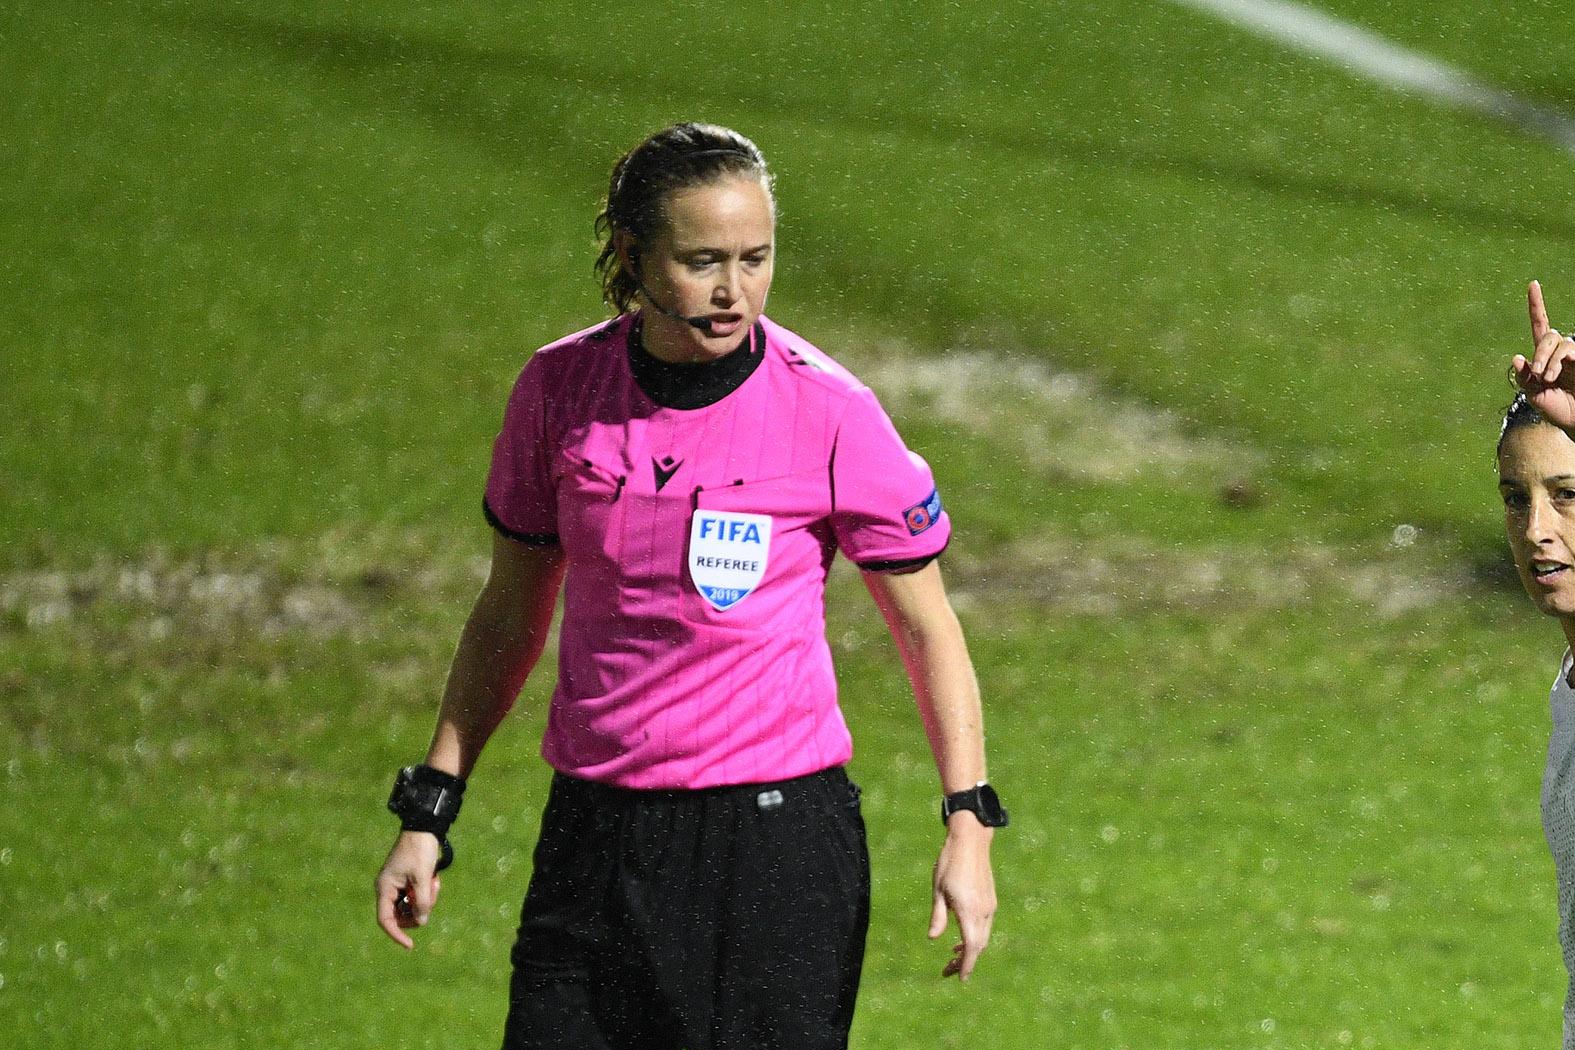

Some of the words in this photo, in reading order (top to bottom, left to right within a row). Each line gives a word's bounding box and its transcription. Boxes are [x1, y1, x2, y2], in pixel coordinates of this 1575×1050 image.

[700, 518, 760, 544] FIFA
[696, 556, 759, 572] REFEREE
[709, 587, 739, 600] 2019
